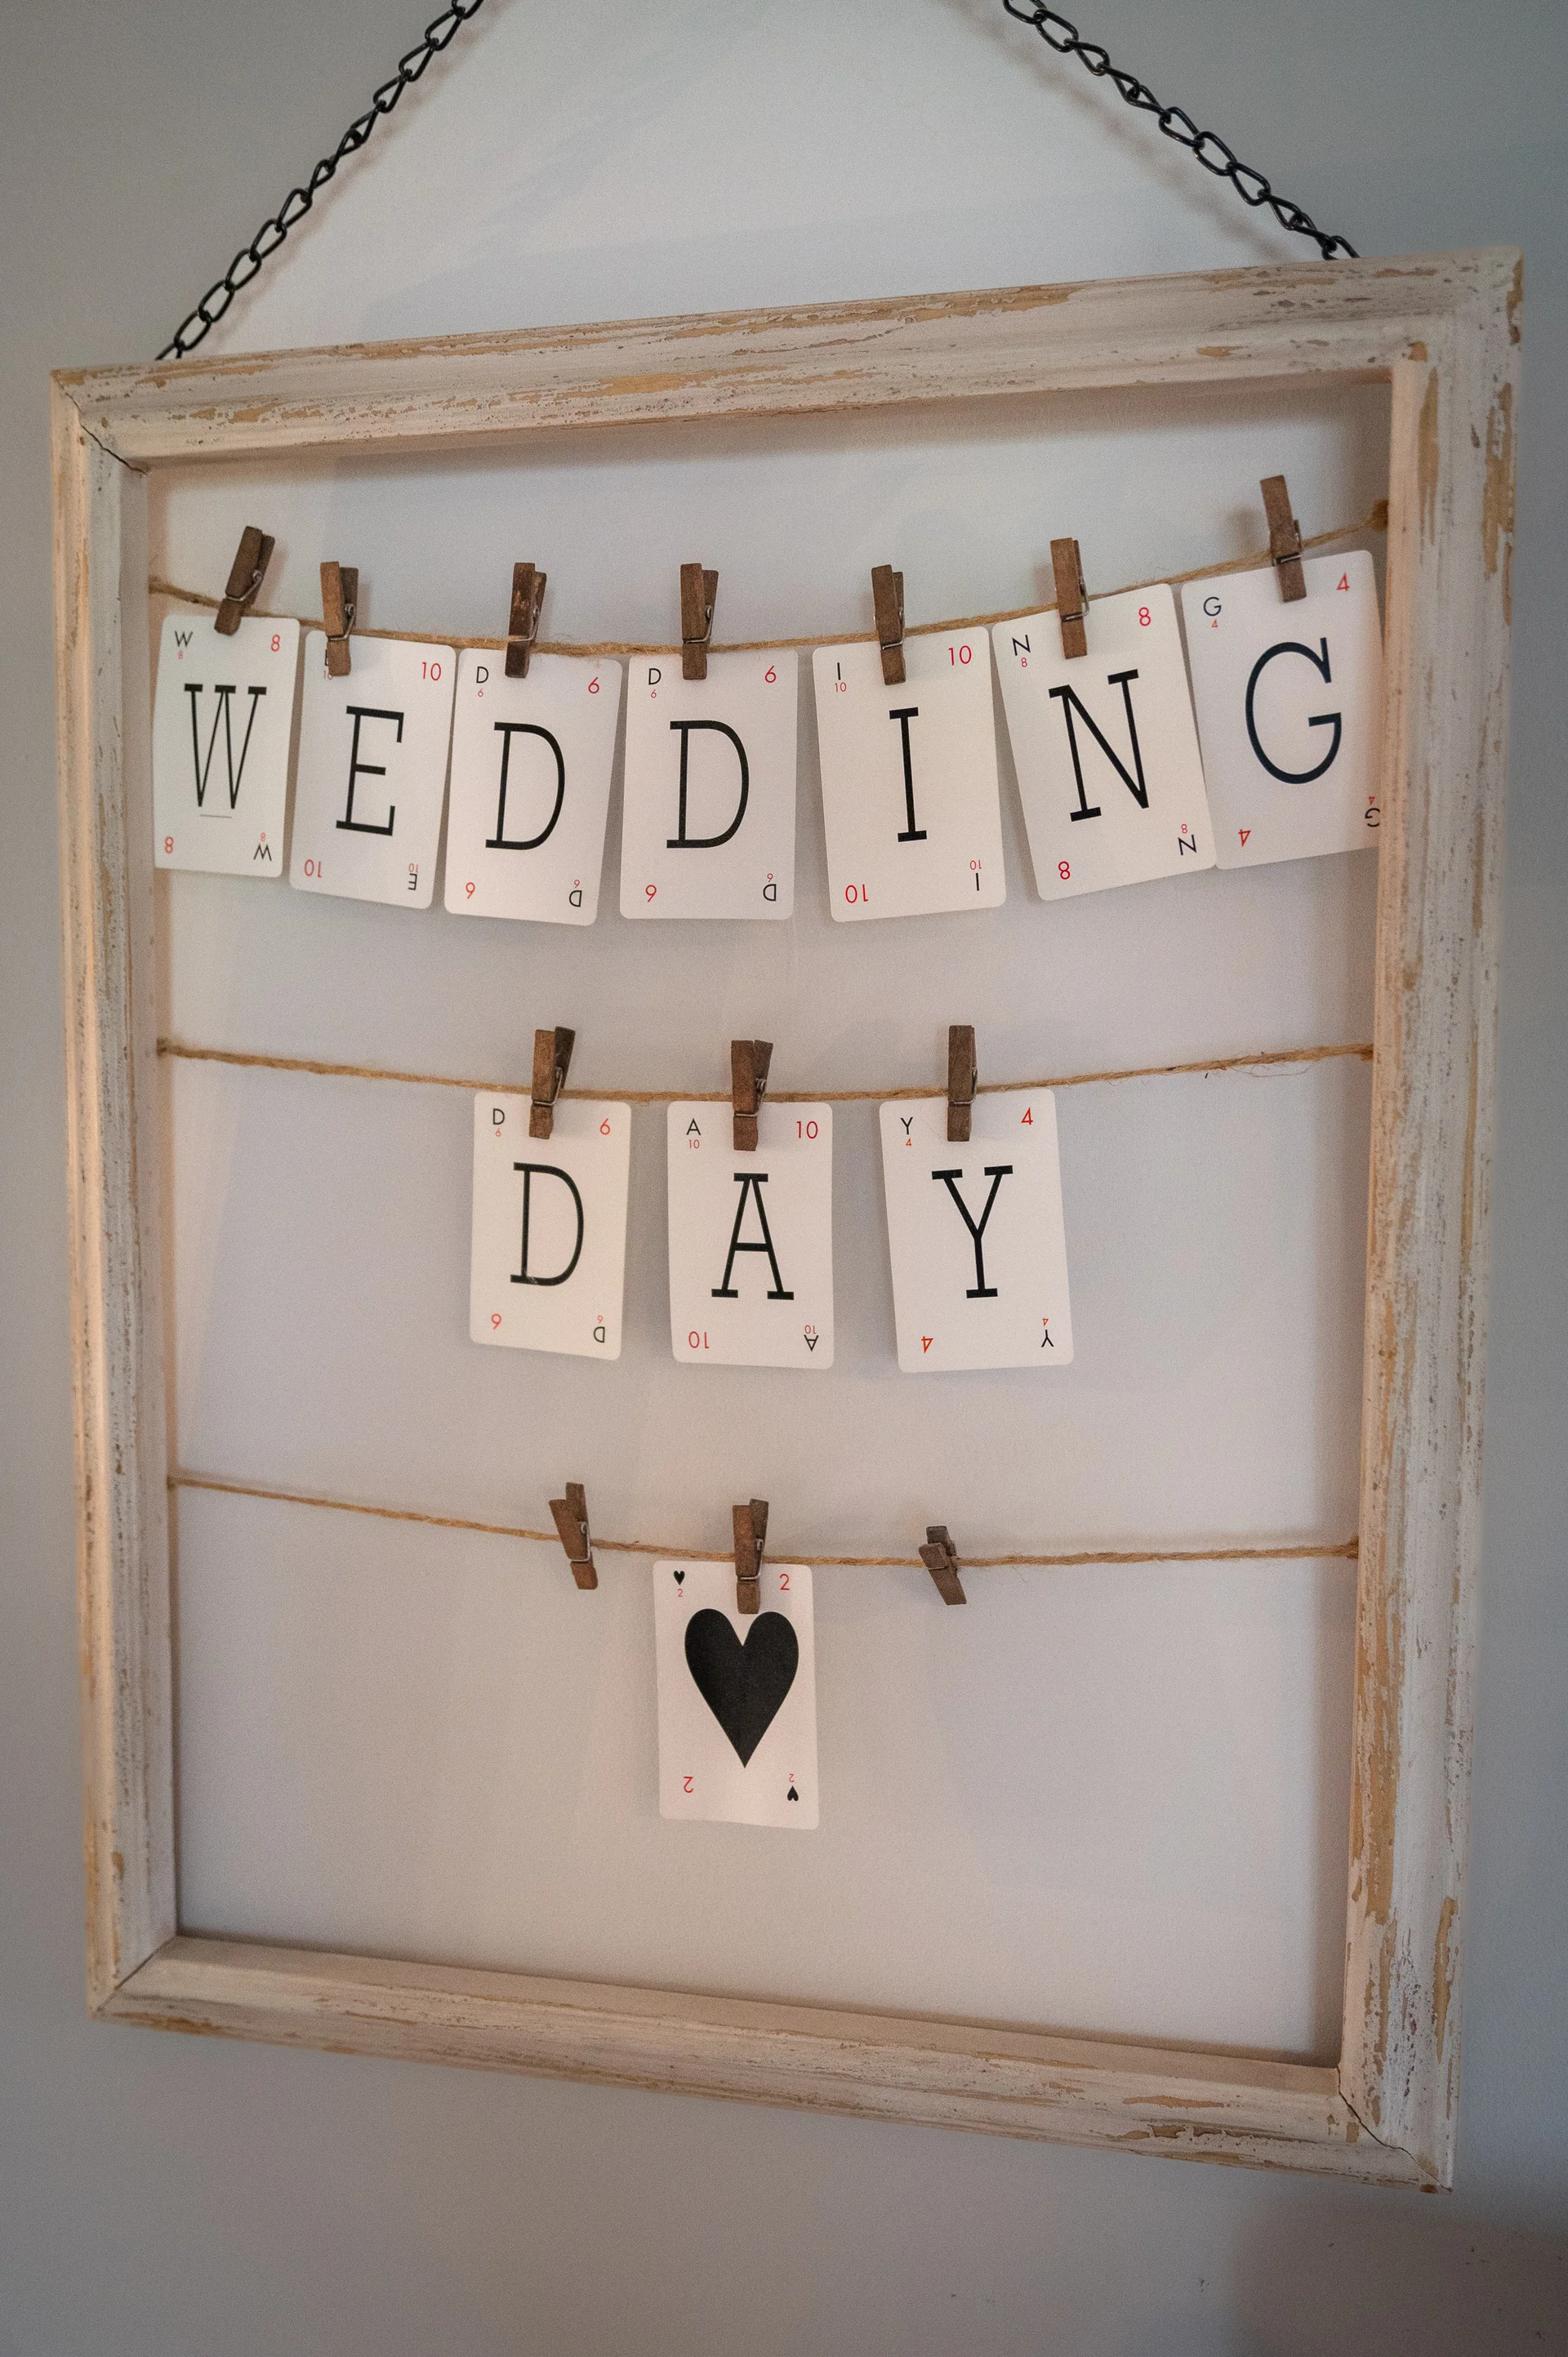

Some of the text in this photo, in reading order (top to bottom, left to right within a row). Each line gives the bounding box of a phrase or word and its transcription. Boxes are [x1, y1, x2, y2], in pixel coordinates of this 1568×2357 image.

[1337, 574, 1349, 590] 4
[1204, 597, 1221, 617] G
[1138, 607, 1151, 626] 8
[175, 631, 193, 646] W
[271, 635, 280, 652] 8
[1013, 635, 1031, 656] N
[949, 645, 972, 666] 10
[422, 662, 441, 681] 10
[476, 666, 488, 684] D
[648, 668, 662, 685] D
[765, 666, 776, 683] 6
[588, 677, 599, 693] 6
[493, 1108, 505, 1125] D
[1022, 1107, 1033, 1125] 4
[600, 1119, 610, 1135] 6
[687, 1119, 701, 1135] A
[797, 1121, 818, 1138] 10
[901, 1116, 913, 1134] Y
[780, 1574, 789, 1590] 2
